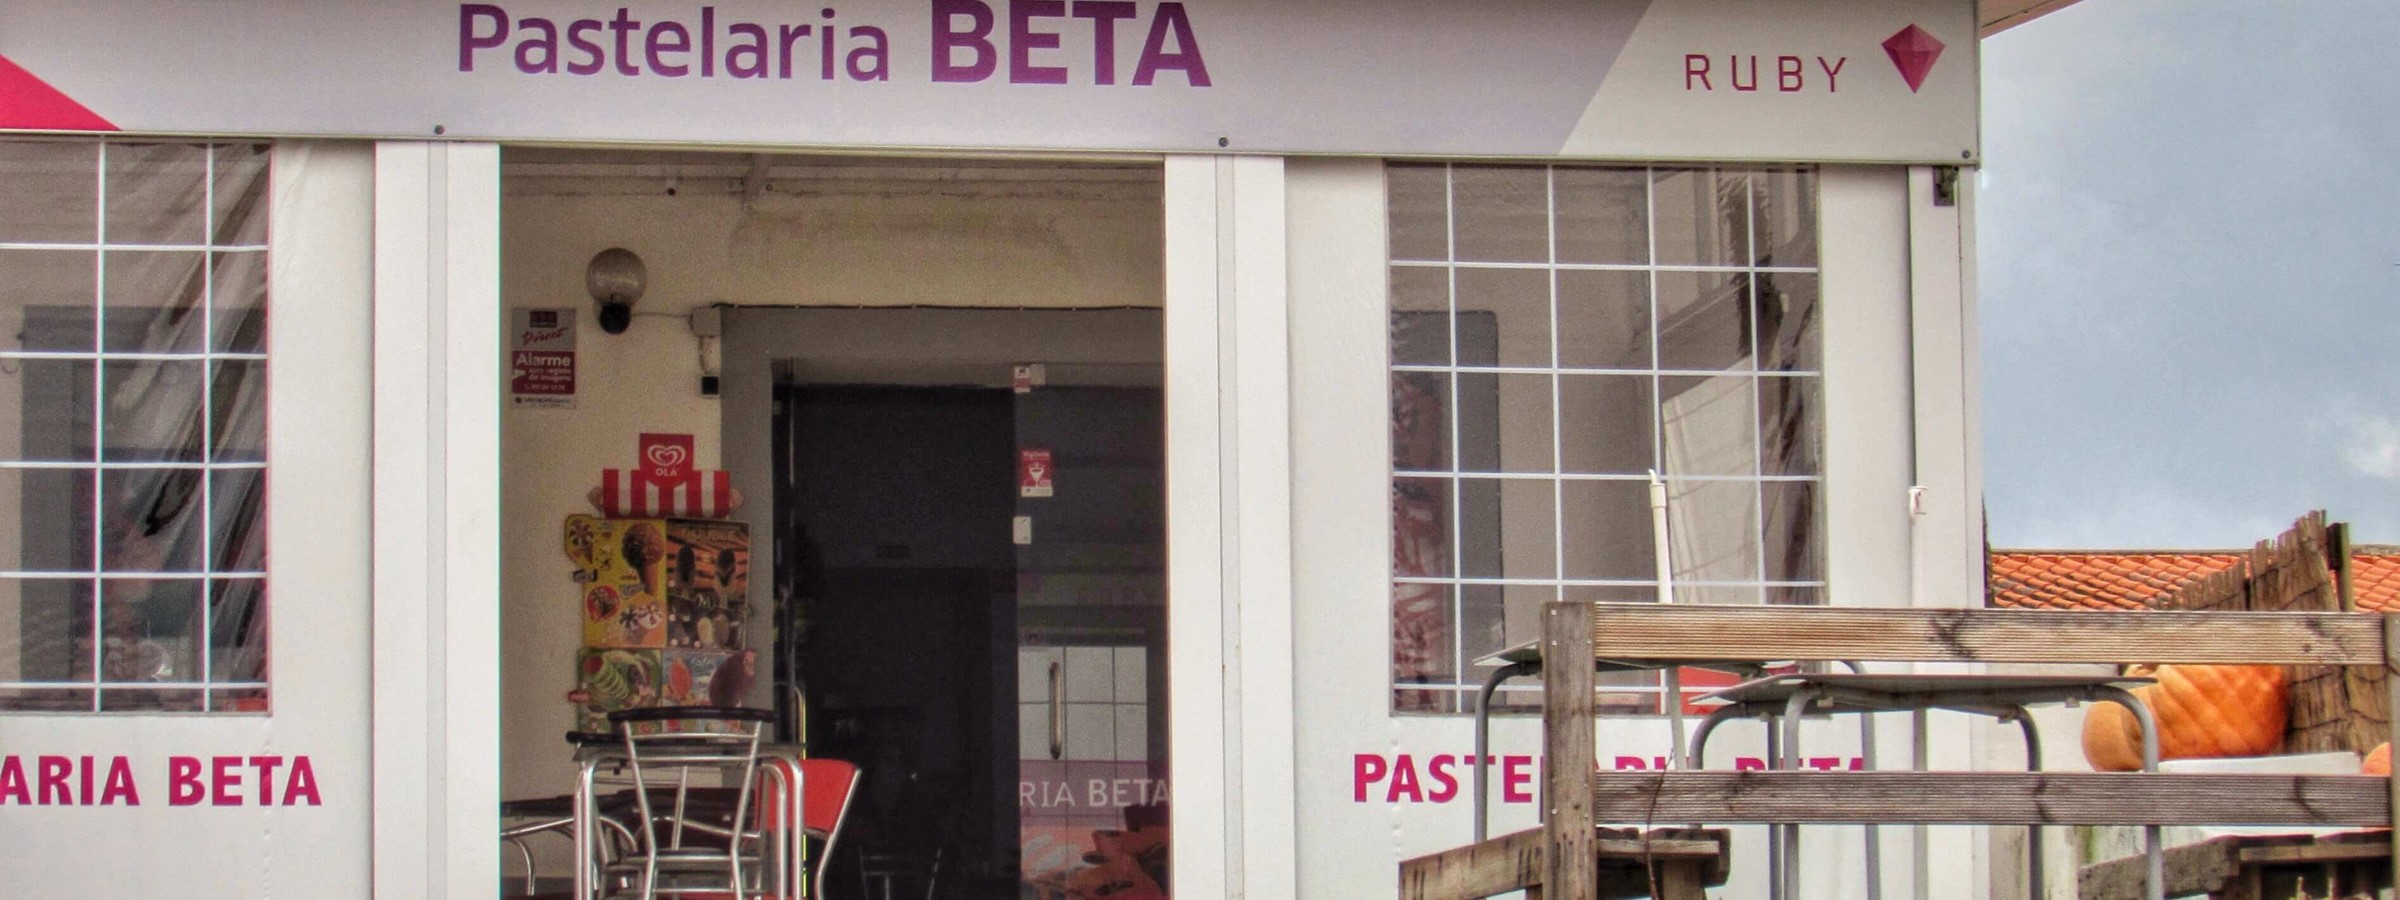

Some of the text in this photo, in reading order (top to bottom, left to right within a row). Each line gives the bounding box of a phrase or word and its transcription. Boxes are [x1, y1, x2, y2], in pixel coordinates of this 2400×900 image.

[459, 0, 1212, 87] Pastelaria BETA
[1685, 54, 1847, 93] RUBY
[516, 352, 572, 367] Alarme
[0, 755, 322, 806] ARIA BETA
[1019, 779, 1169, 808] RIA BETA
